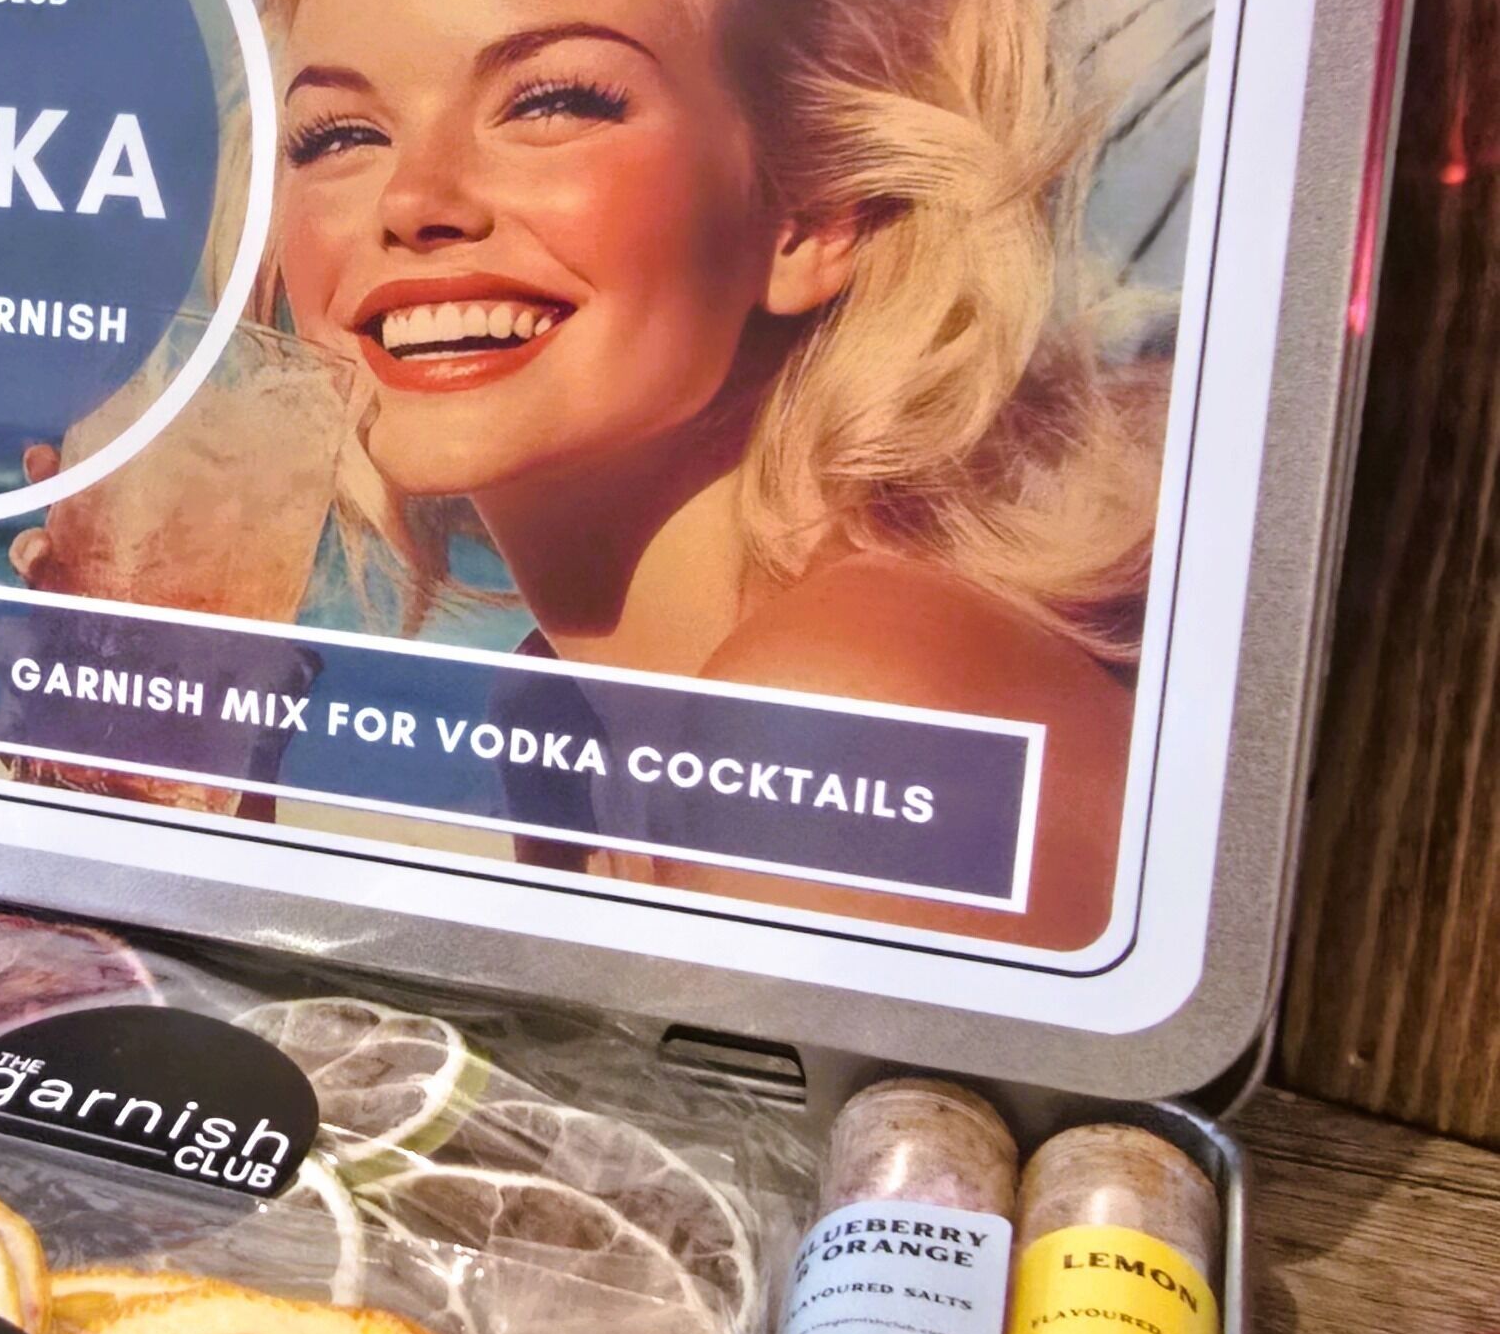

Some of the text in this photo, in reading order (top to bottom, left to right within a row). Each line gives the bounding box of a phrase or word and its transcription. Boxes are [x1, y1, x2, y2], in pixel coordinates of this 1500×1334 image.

[10, 657, 203, 716] GARNISH
[220, 686, 309, 732] MIX
[326, 701, 417, 749] FOR
[435, 718, 608, 777] VODKA
[626, 746, 936, 824] COCKTAILS
[173, 1144, 278, 1190] CLUB
[821, 1238, 975, 1268] ORANGE
[903, 1286, 974, 1311] SALTS
[1062, 1252, 1199, 1315] LEMON
